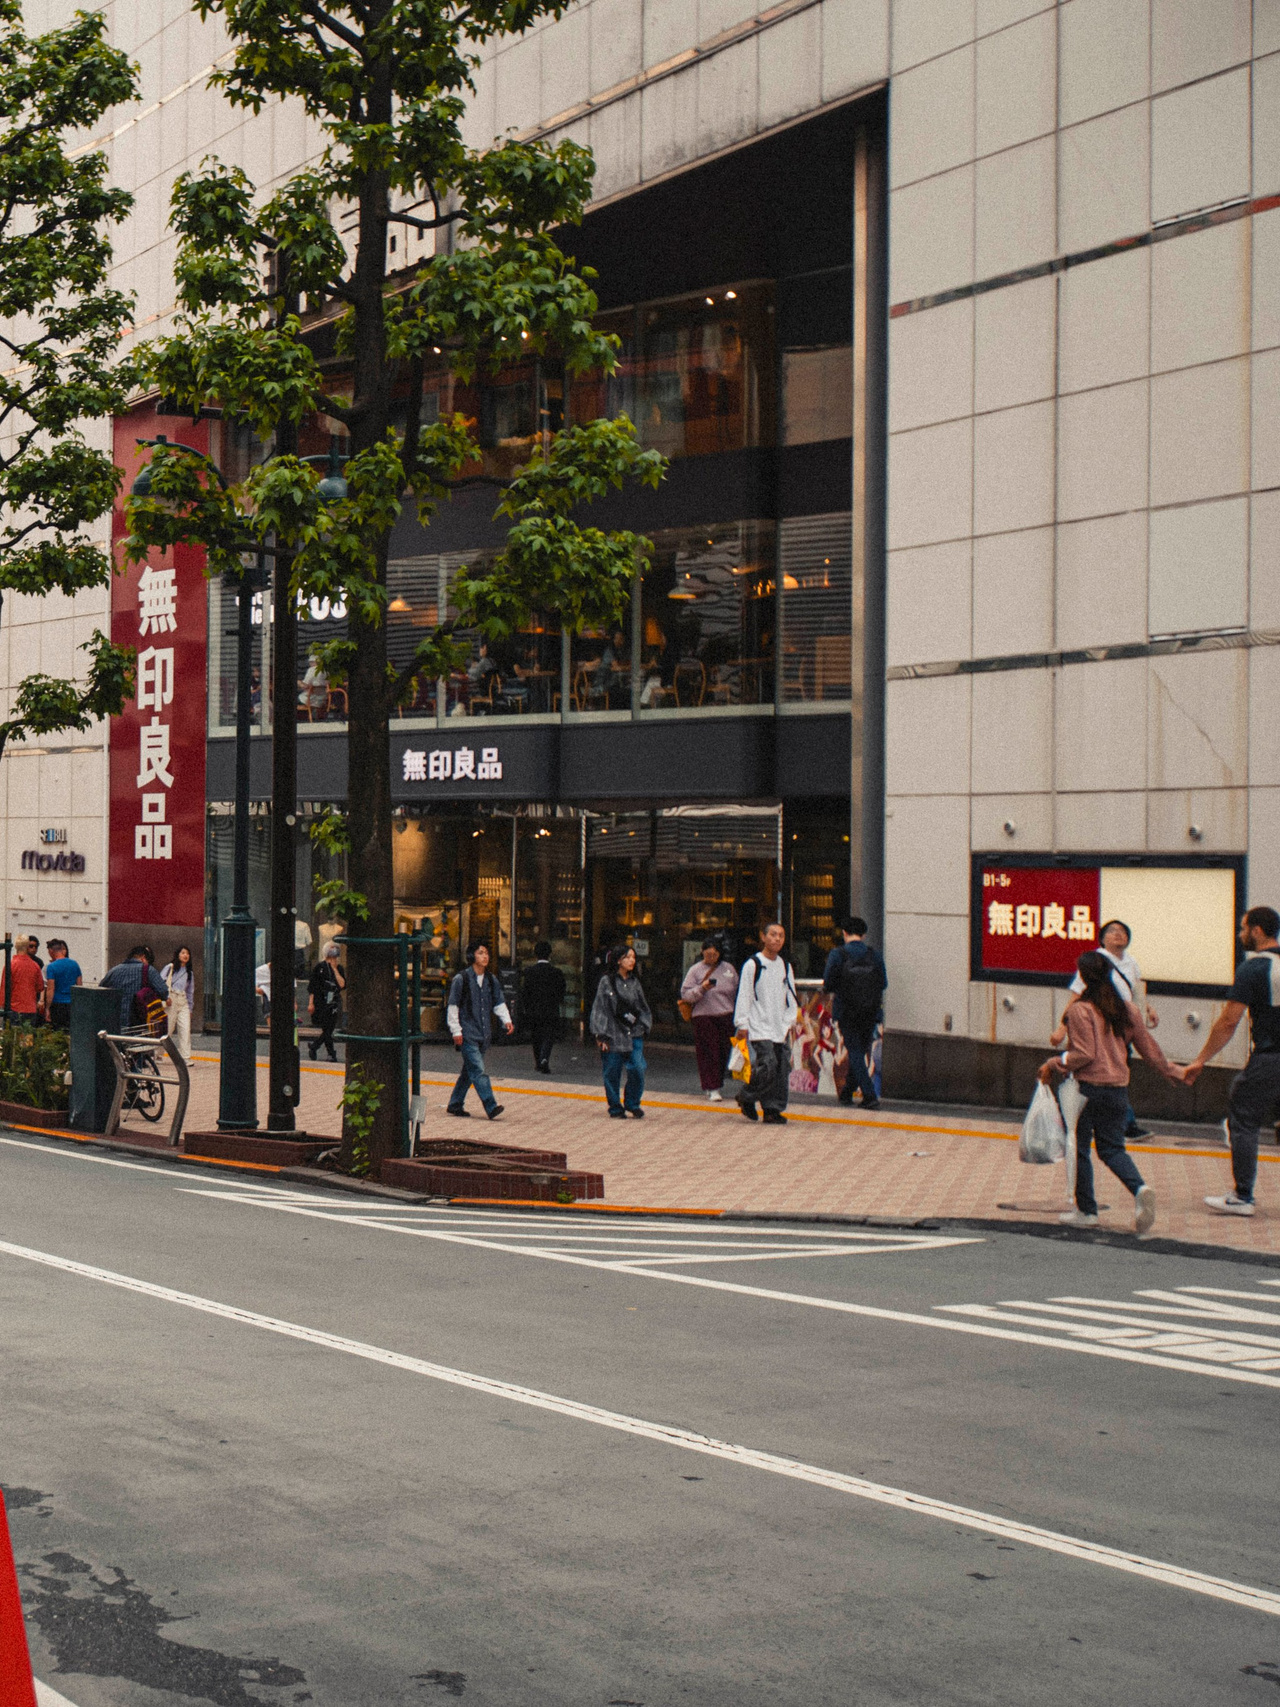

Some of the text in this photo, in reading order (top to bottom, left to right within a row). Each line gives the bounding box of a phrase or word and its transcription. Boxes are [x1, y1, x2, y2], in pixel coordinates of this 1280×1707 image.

[134, 566, 178, 860] 無印良品
[402, 746, 503, 781] 無印良品
[988, 900, 1096, 941] 無印良品
